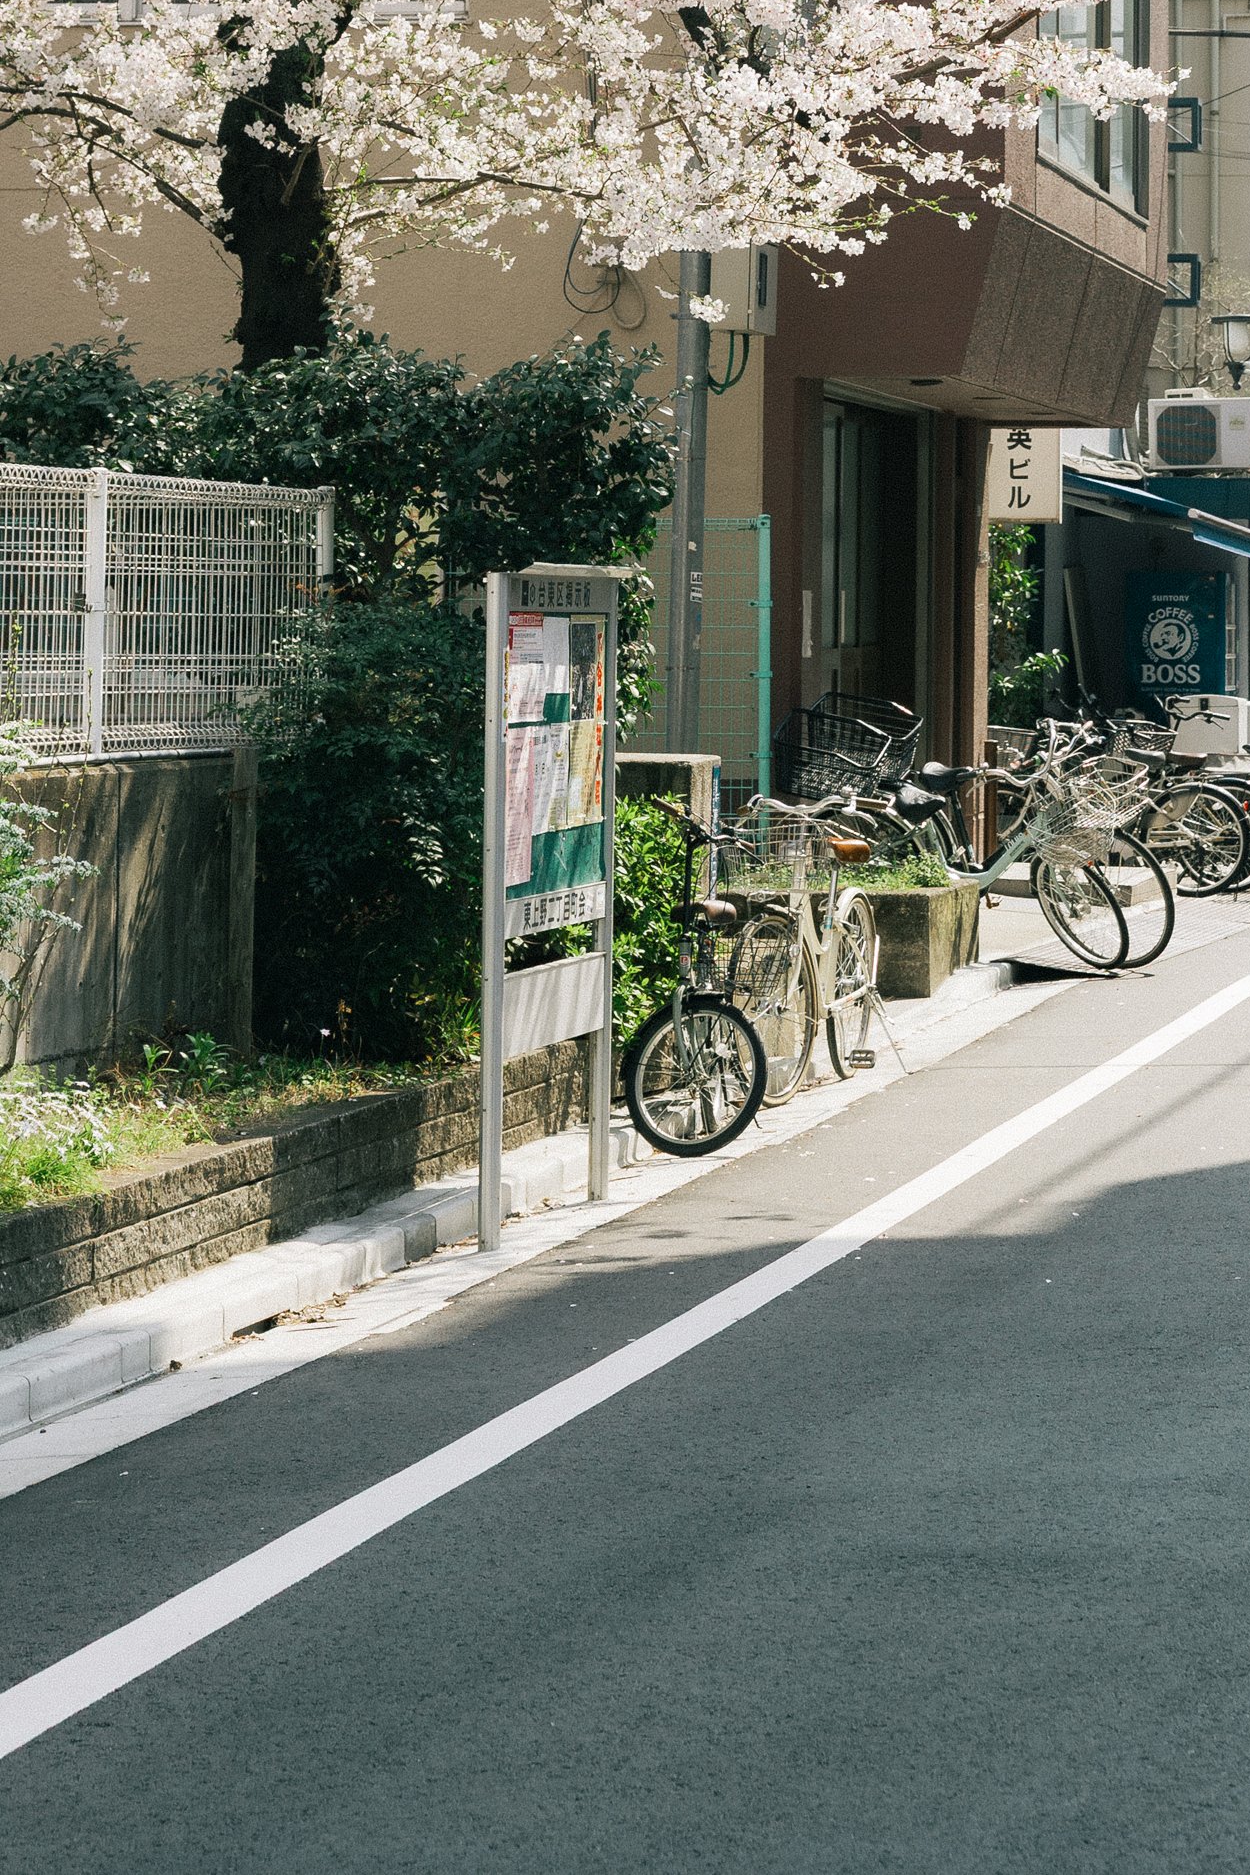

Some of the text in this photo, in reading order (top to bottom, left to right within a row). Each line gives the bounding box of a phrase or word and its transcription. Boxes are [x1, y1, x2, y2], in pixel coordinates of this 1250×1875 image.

[1148, 607, 1194, 623] COFFEE
[1140, 664, 1201, 684] BOSS
[523, 891, 586, 931] 東上野二丁目町会
